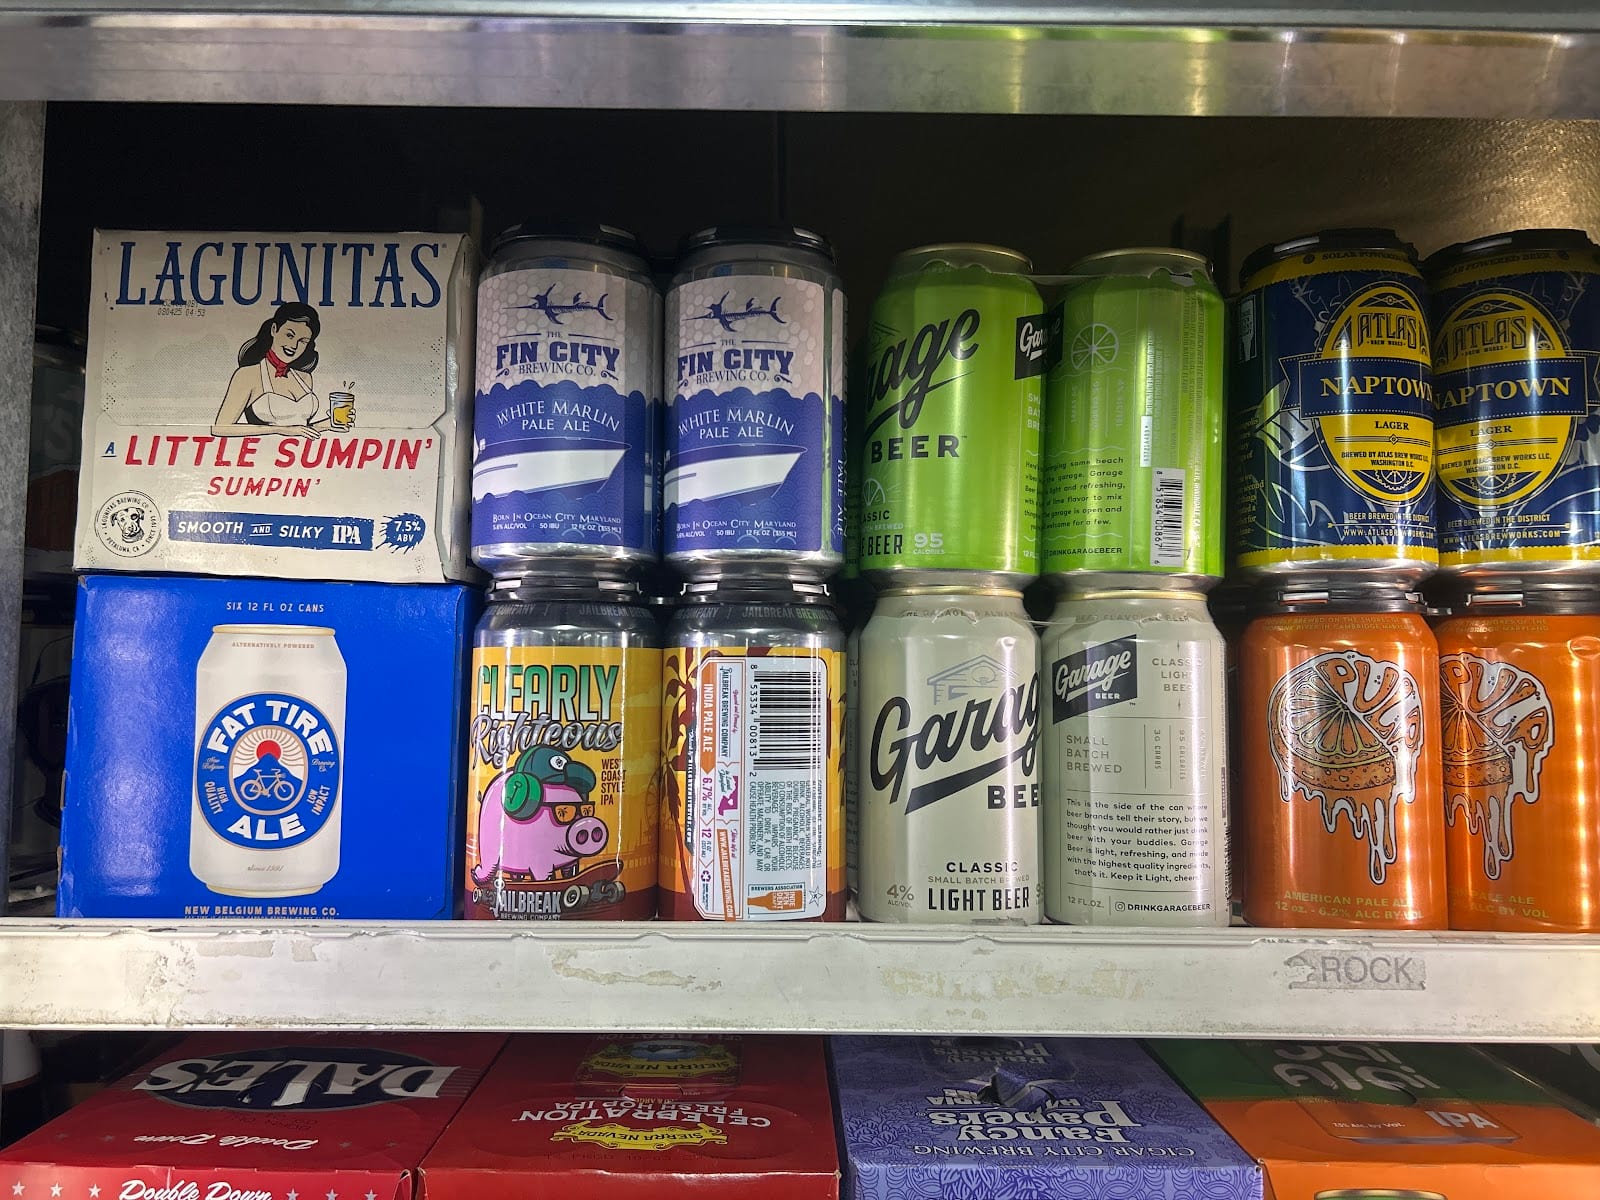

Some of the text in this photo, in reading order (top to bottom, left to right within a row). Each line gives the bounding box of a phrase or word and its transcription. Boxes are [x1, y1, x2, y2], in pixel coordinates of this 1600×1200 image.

[116, 242, 441, 308] LAGUNITAS
[1357, 312, 1417, 350] ATLAS
[1452, 315, 1527, 361] ATLAS
[496, 341, 620, 372] FIN CITY
[518, 362, 573, 375] BREWING
[677, 348, 795, 383] FIN CITY
[696, 369, 747, 385] BREWING
[1320, 376, 1433, 403] NAPTOWN
[497, 400, 620, 432] WHITE MARLIN
[678, 408, 795, 438] WHITE MARLIN
[521, 419, 590, 432] PALE ALE
[699, 426, 764, 440] PALE ALE
[1374, 420, 1410, 431] LAGER
[1469, 424, 1513, 437] LAGER
[104, 435, 433, 469] A LITTLE SUMPIN'
[871, 434, 960, 465] BEER
[836, 459, 844, 497] PALE
[1090, 470, 1123, 478] Garage
[207, 476, 321, 498] SUMPIN'
[1079, 481, 1126, 490] refreshing,
[116, 496, 142, 506] BREWING
[1155, 487, 1165, 515] 51834
[579, 514, 622, 524] MARYLAND
[702, 519, 797, 530] OCEAN MARYLAND
[1517, 513, 1551, 523] DISTRICT
[177, 521, 362, 545] SMOOTH AND SILKY IPA
[394, 519, 422, 533] 7.5%
[396, 533, 414, 543] ABV
[914, 532, 944, 549] 95
[1443, 530, 1561, 544] WWW.ATLASBREWWORKS.COM
[867, 534, 903, 556] BEER
[226, 601, 325, 613] SIX CANS
[578, 604, 630, 617] JAILBREAK
[742, 606, 795, 618] JAILBREAK
[231, 641, 315, 650] ALTERNATIVELY POWERED
[1055, 649, 1132, 700] Garage
[720, 666, 732, 699] JAILBREAK
[477, 664, 620, 722] CLEARLY
[1095, 692, 1121, 700] BEER
[703, 683, 714, 734] INDIA PALE
[1315, 657, 1420, 748] PULP
[206, 700, 334, 756] FAT TIRE
[749, 684, 758, 757] 53334 00813
[471, 712, 623, 770] Righteous
[1066, 735, 1109, 746] SMALL
[1066, 748, 1110, 760] BATCH
[1154, 745, 1162, 770] CARBS
[601, 758, 624, 770] WEST
[1066, 762, 1123, 774] BREWED
[601, 769, 627, 782] COAST
[216, 786, 230, 804] HIGH
[600, 781, 626, 794] STYLE
[204, 781, 224, 815] QUALITY
[306, 788, 319, 805] LOW
[311, 784, 331, 816] IMPACT
[600, 793, 614, 806] IPA
[1094, 801, 1109, 809] the
[1113, 802, 1132, 810] side
[1150, 803, 1165, 811] the
[1084, 811, 1182, 824] brands tell their story,
[226, 813, 306, 841] ALE
[1067, 821, 1189, 836] thought you would rather just
[1066, 832, 1176, 847] beer with your buddies.
[1067, 844, 1187, 859] Beer light, refreshing, and
[946, 862, 1019, 873] CLASSIC
[1067, 855, 1165, 871] with highest quality
[928, 875, 997, 885] SMALL BATCH
[1074, 868, 1172, 883] that's Keep Light,
[886, 884, 915, 901] 4%
[928, 887, 986, 912] LIGHT
[992, 886, 1030, 911] BEER
[1067, 895, 1076, 904] 12
[1283, 890, 1389, 907] AMERICAN PALE
[1508, 895, 1535, 905] ALE
[492, 889, 562, 915] JAILBREAK
[1127, 903, 1211, 912] DRINKGARAGEBEER
[184, 905, 318, 916] NEW BELGIUM BREWING
[500, 913, 561, 921] BREWING COMPANY
[1355, 909, 1380, 919] ALC
[1521, 908, 1550, 919] VOL
[1321, 956, 1415, 984] ROCK
[590, 1059, 730, 1071] SIERRA NEVADA
[133, 1058, 461, 1108] DALE'S
[555, 1101, 597, 1110] IPA
[602, 1100, 653, 1110] HOP
[661, 1103, 744, 1116] FRESH
[518, 1109, 772, 1127] CELEBRATION
[928, 1100, 1142, 1127] Papers
[1424, 1110, 1500, 1129] IPA
[132, 1132, 320, 1151] Double Down
[577, 1129, 704, 1142] SIERRA NEVADA
[957, 1125, 1131, 1143] Fancy
[914, 1145, 1195, 1156] CIGAR CITY BREWING
[119, 1179, 273, 1200] Double Down
